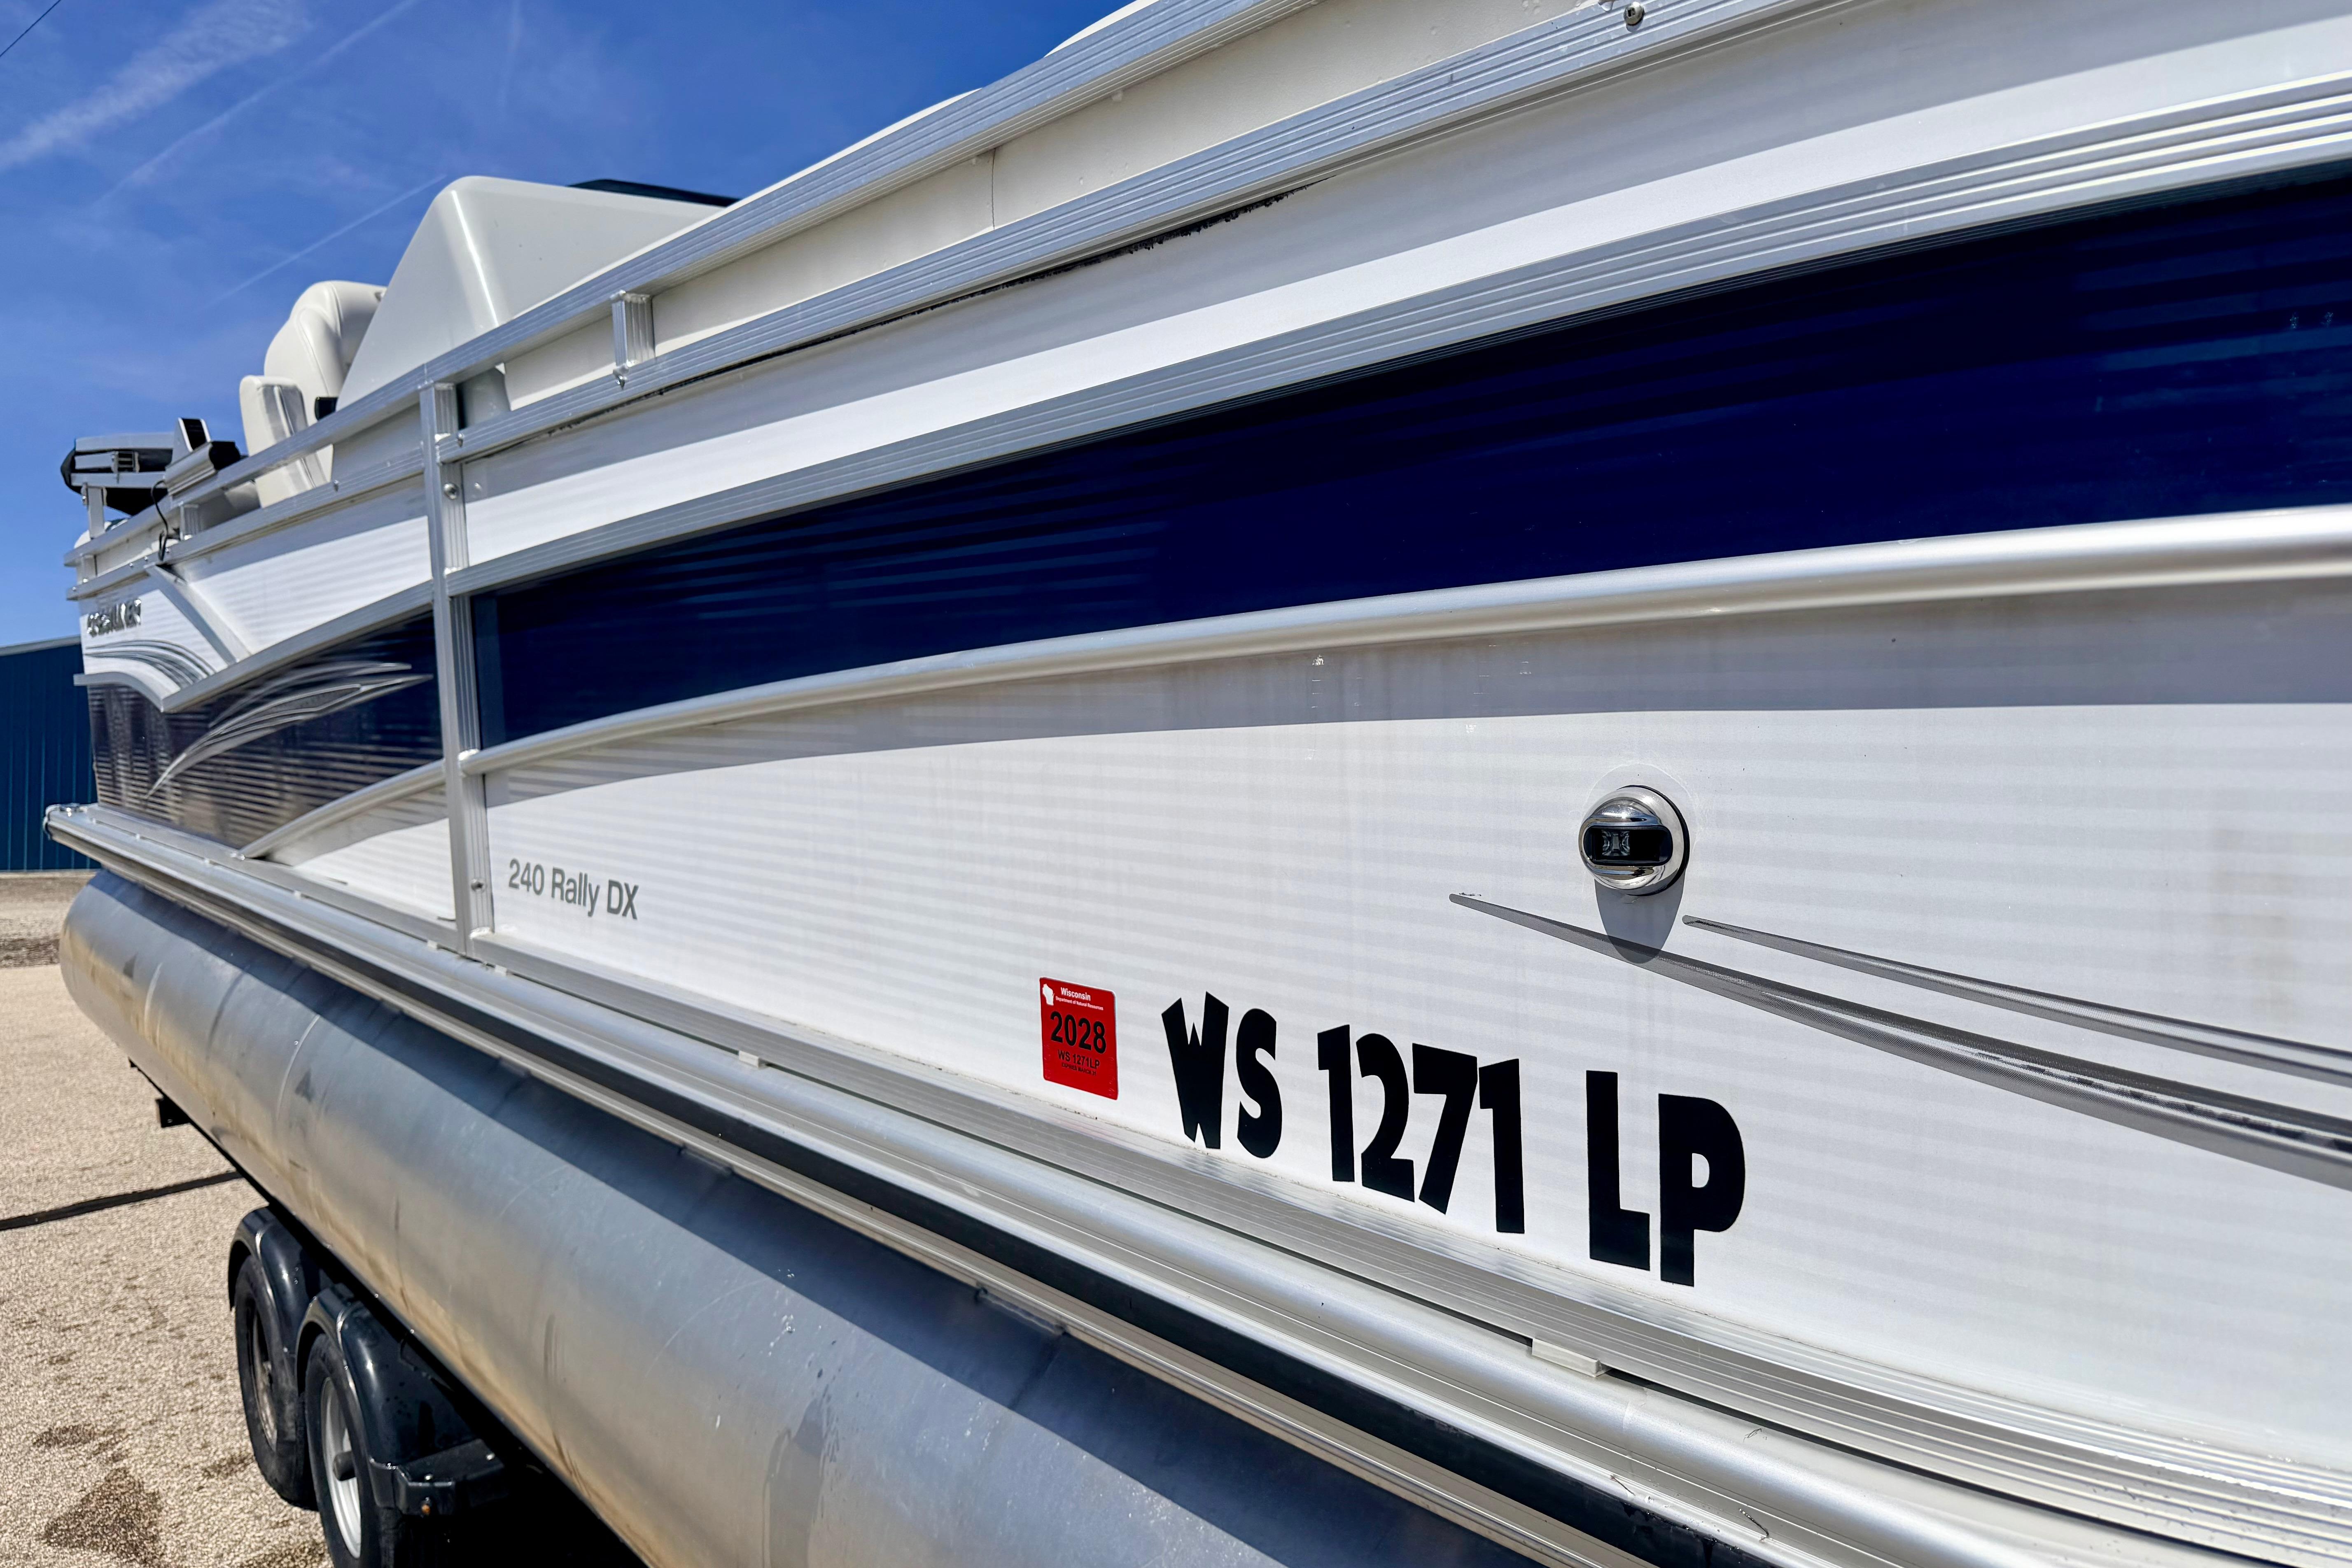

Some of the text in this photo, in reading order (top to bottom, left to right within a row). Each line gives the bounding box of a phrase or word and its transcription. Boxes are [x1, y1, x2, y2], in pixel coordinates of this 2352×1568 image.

[509, 859, 639, 920] 240 Rally DX
[1061, 987, 1091, 1001] Wisconsin
[1051, 1011, 1107, 1054] 2028
[1058, 1049, 1071, 1062] WS
[1161, 991, 1746, 1288] WS 1271 LP
